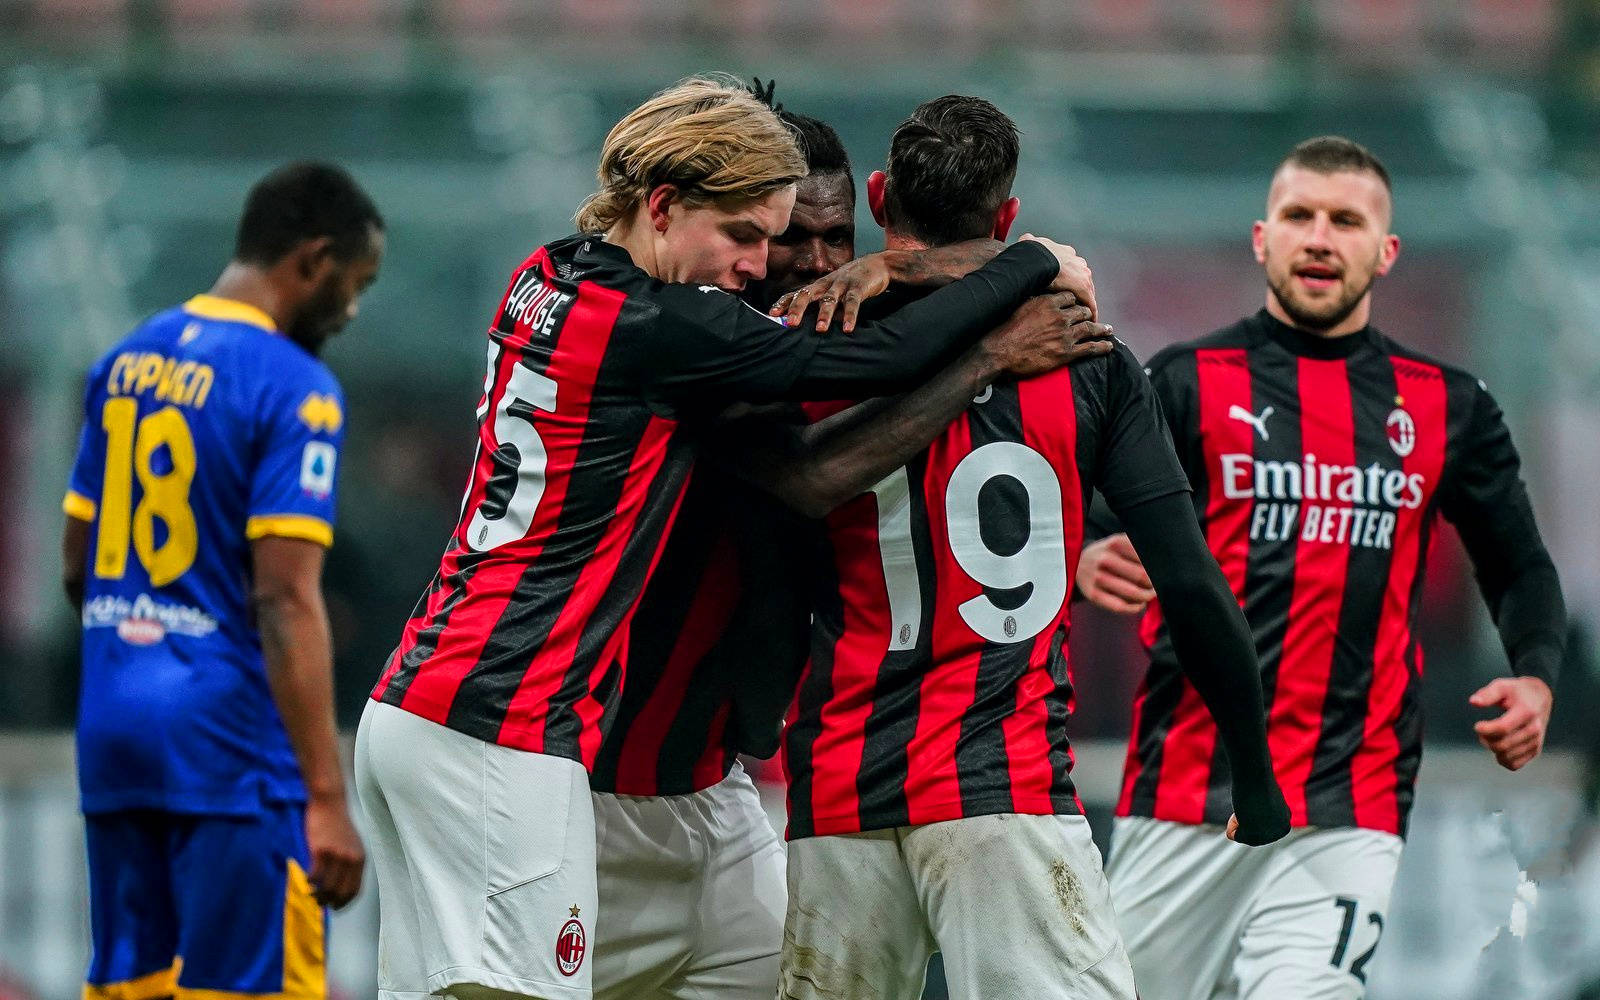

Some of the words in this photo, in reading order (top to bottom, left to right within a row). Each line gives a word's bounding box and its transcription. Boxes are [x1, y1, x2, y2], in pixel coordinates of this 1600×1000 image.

[505, 270, 571, 335] HAUGE
[95, 396, 198, 588] 18
[1220, 453, 1424, 509] Emirates
[866, 441, 1067, 651] 19
[1250, 503, 1298, 541] FLY
[1302, 505, 1396, 550] BETTER
[1329, 896, 1384, 985] 12
